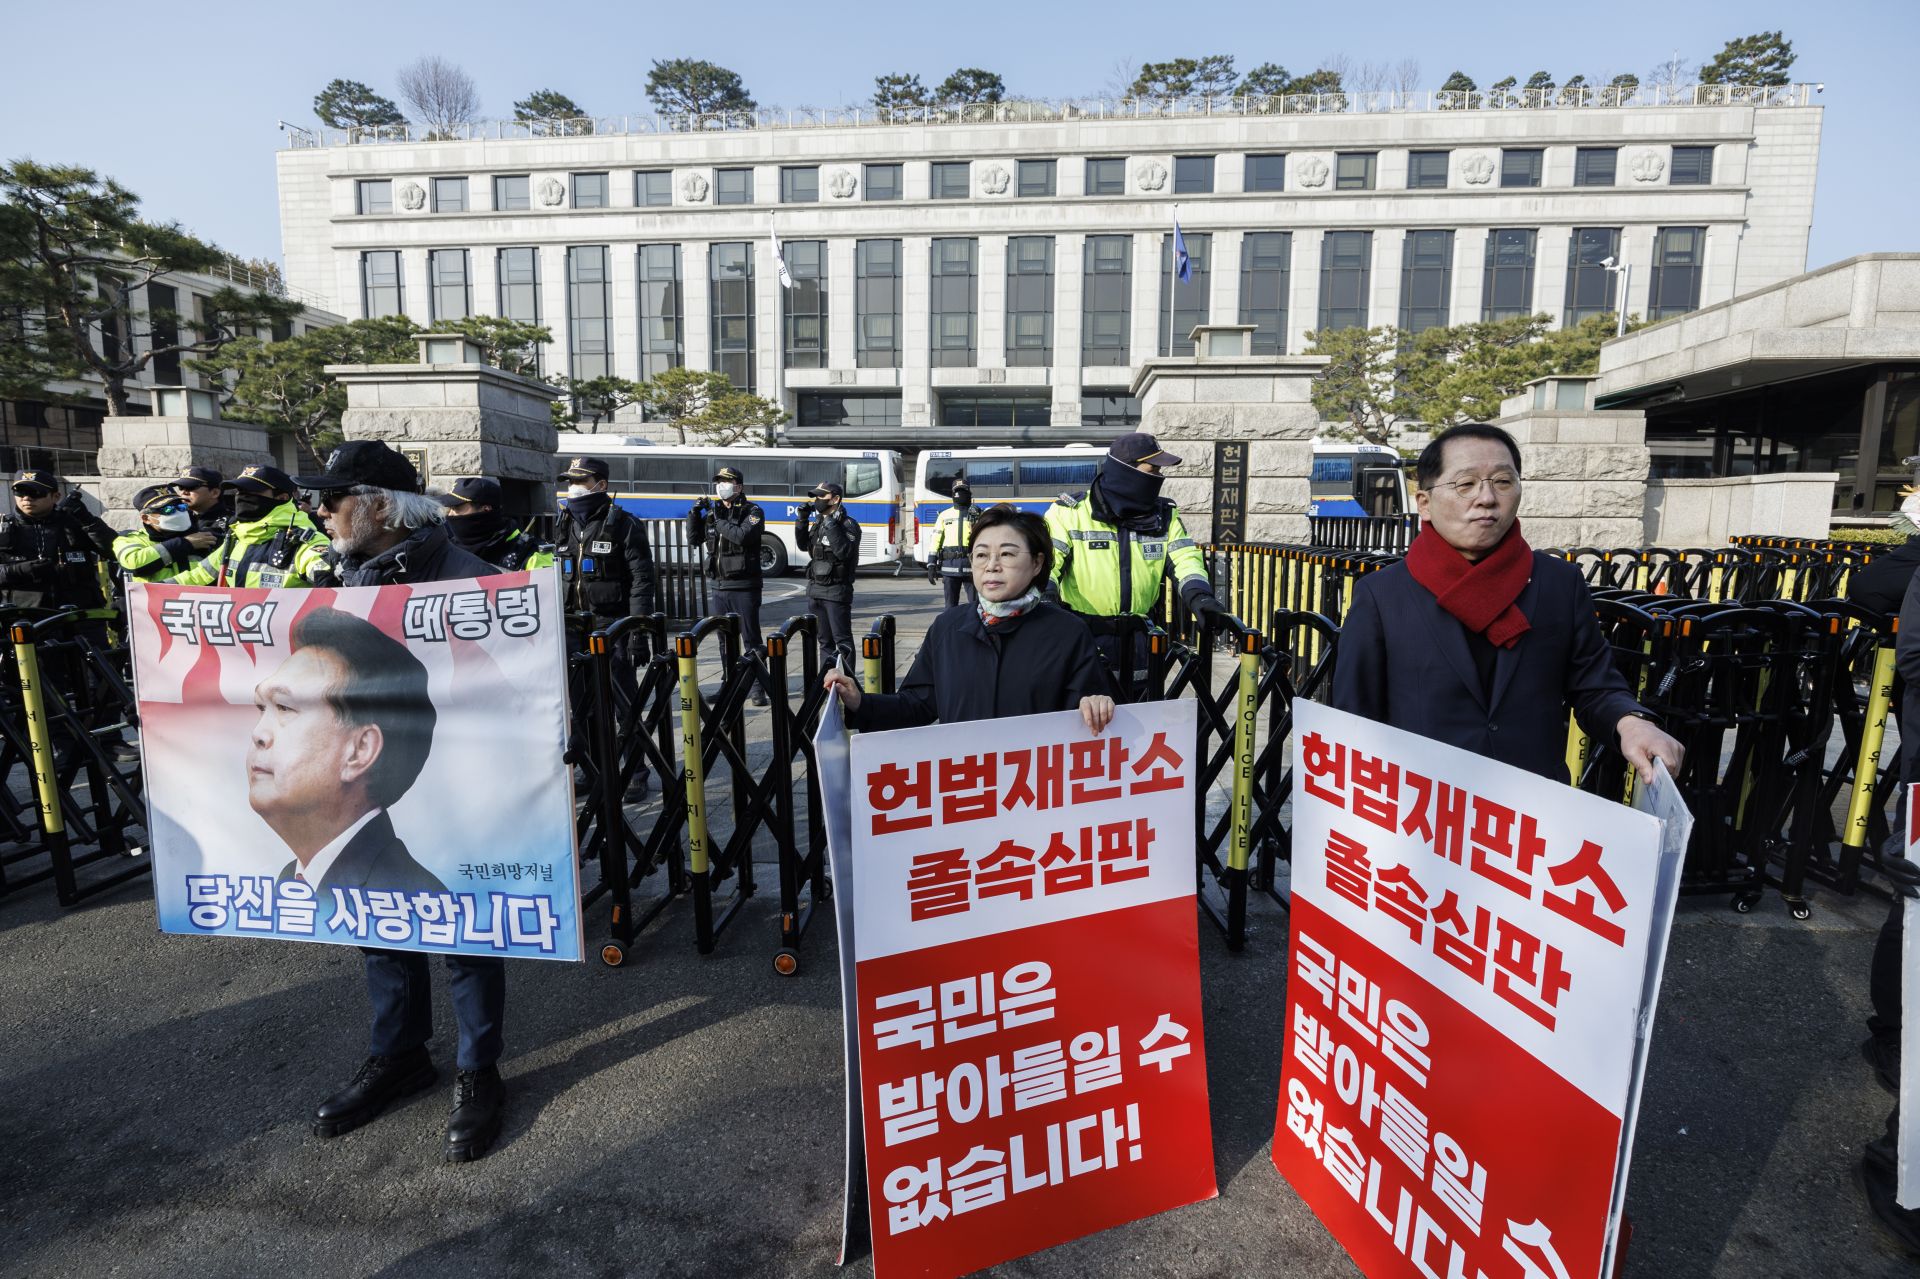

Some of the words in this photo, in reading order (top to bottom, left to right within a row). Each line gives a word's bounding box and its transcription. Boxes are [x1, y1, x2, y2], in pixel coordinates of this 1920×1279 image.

[1219, 445, 1241, 546] 헌법재판소
[161, 599, 278, 646] 국민의
[403, 584, 540, 642] 대통령
[681, 697, 702, 851] 질서유지선
[868, 734, 1185, 835] 헌법재판소
[1241, 695, 1255, 779] POLICE
[908, 819, 1156, 921] 졸속심판
[1239, 795, 1248, 848] LINE
[1303, 733, 1628, 947] 헌법재판소
[186, 874, 319, 936] 당신을
[326, 883, 561, 953] 사랑합니다
[458, 863, 554, 882] 국민희망저널
[1324, 831, 1572, 1032] 졸속심판
[874, 962, 1057, 1050] 국민은
[1297, 931, 1431, 1089] 국민은
[878, 1026, 1123, 1147] 받아들일
[1139, 1014, 1191, 1074] 수
[1293, 1003, 1484, 1238] 받아들일
[883, 1103, 1142, 1236] 없습니다!
